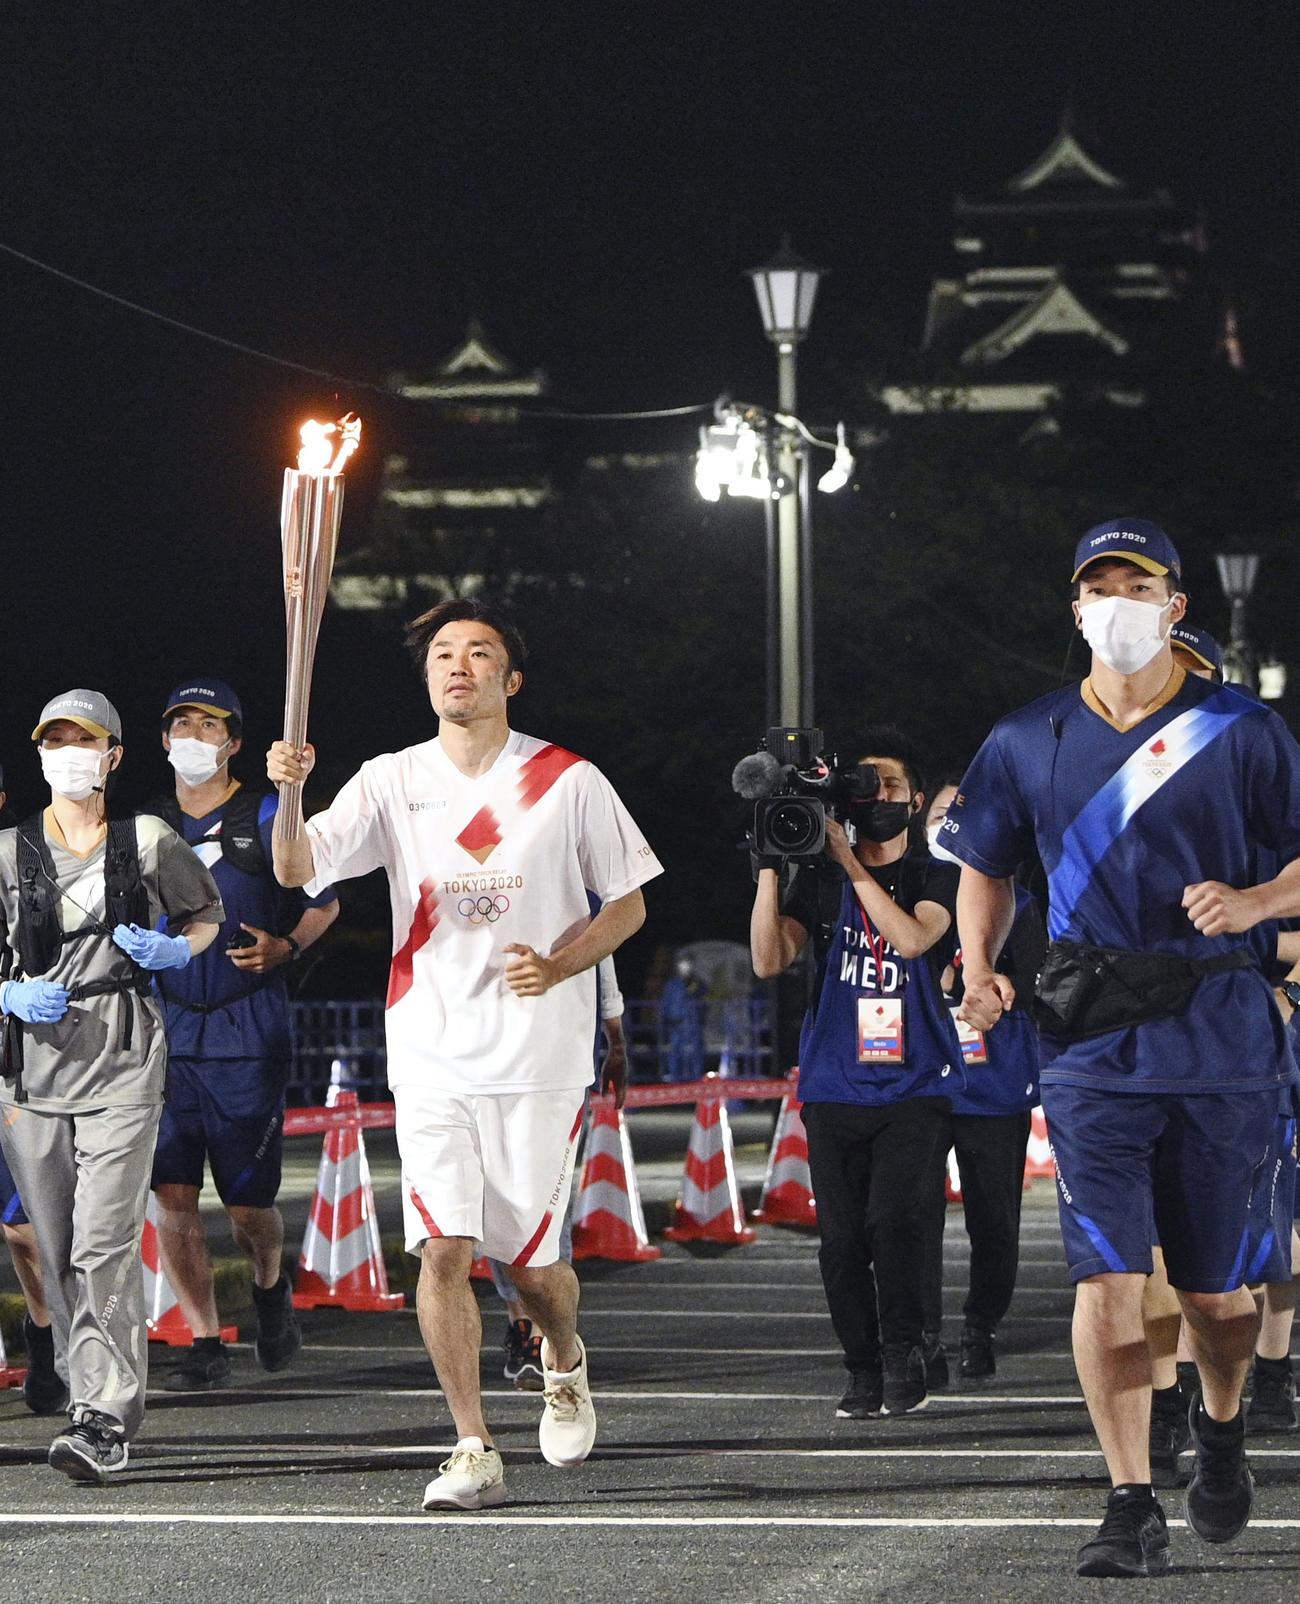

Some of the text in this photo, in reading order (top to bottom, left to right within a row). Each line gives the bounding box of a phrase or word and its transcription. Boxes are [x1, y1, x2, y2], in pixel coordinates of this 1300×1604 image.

[1089, 531, 1147, 547] TOKYO 2020
[1179, 630, 1200, 643] 2020
[198, 687, 216, 697] 2020
[49, 700, 94, 712] TOKYO 2020
[941, 815, 960, 834] 020
[637, 846, 652, 859] TO
[443, 875, 523, 894] TOKYO 2020
[840, 950, 910, 993] MED
[549, 1173, 566, 1207] TOKYO
[1059, 1177, 1073, 1205] 2020
[102, 1295, 118, 1320] 2020
